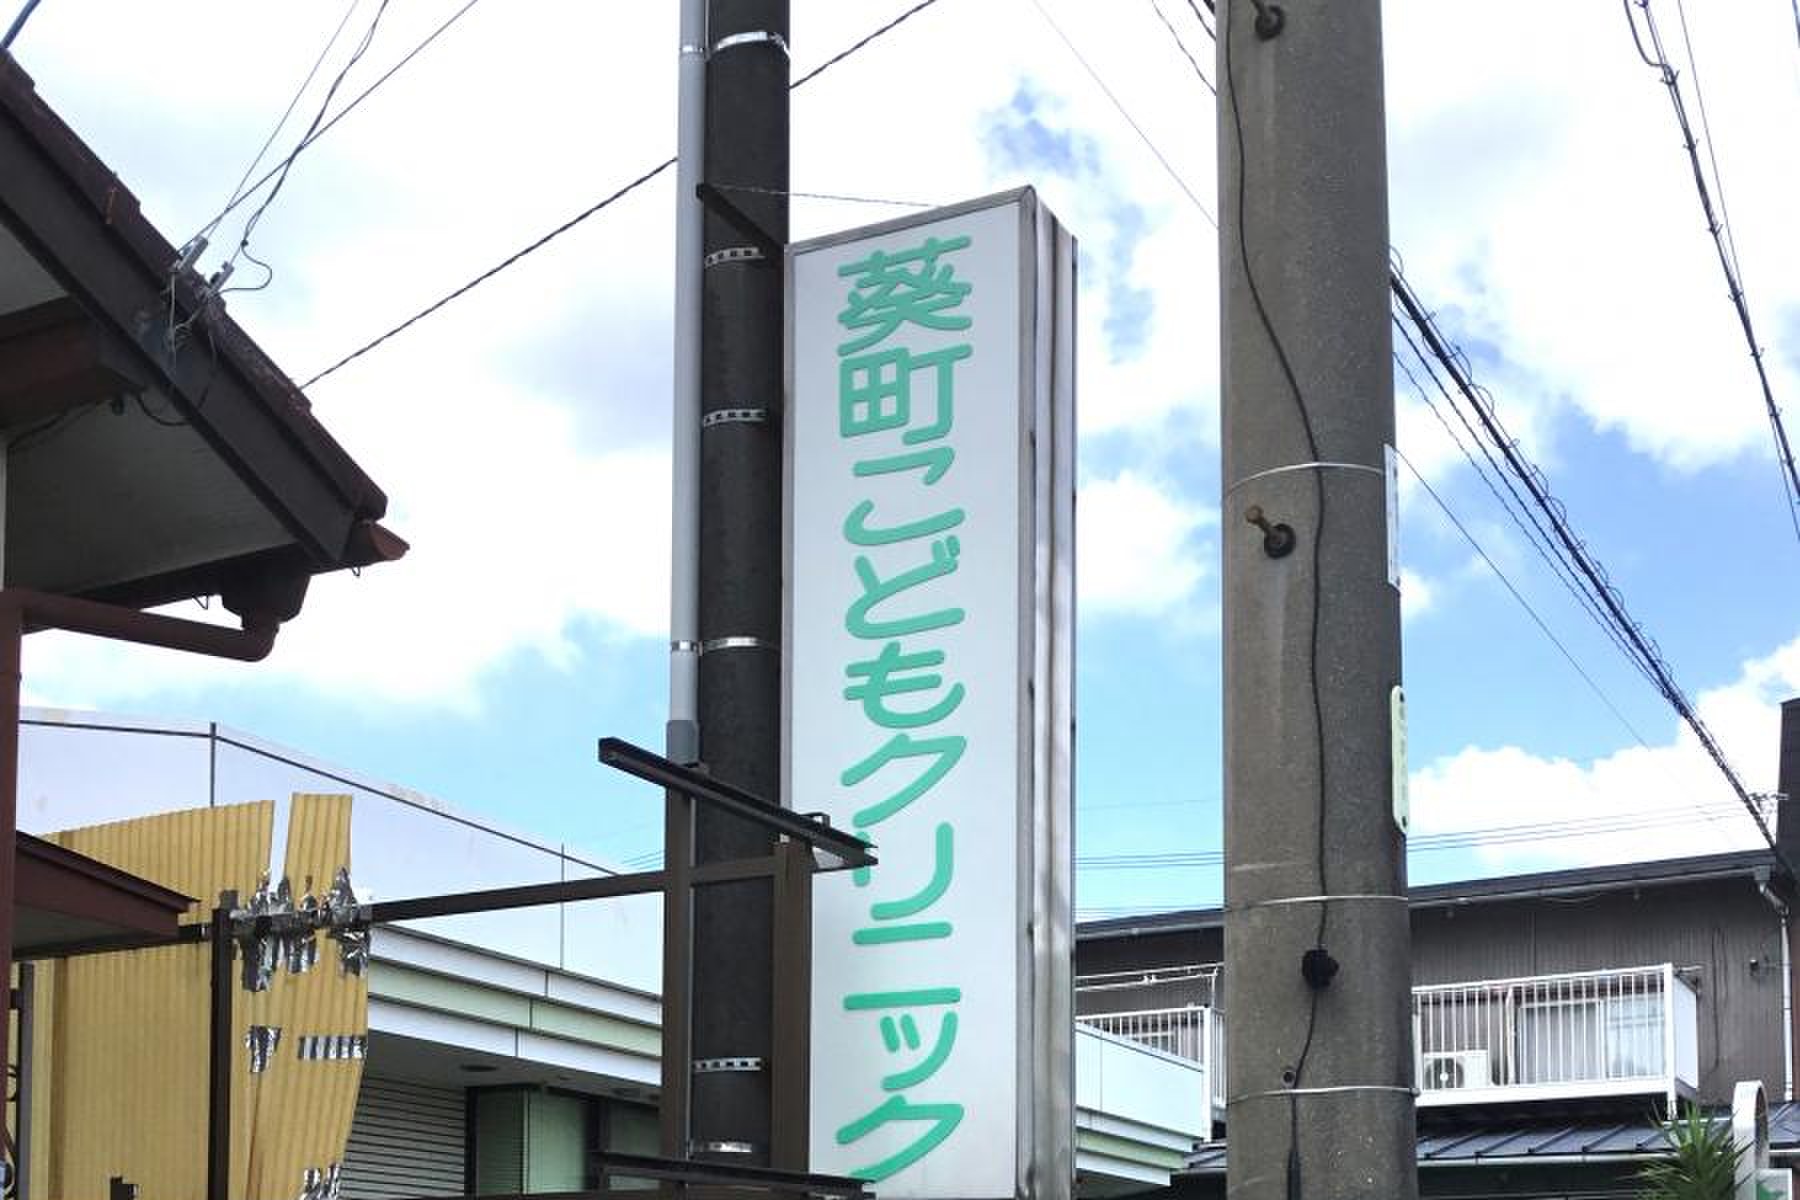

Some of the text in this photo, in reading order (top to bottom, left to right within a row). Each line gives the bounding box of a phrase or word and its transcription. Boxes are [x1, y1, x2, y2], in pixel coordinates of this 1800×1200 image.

[836, 233, 973, 1182] 葵町こどもクリニック
